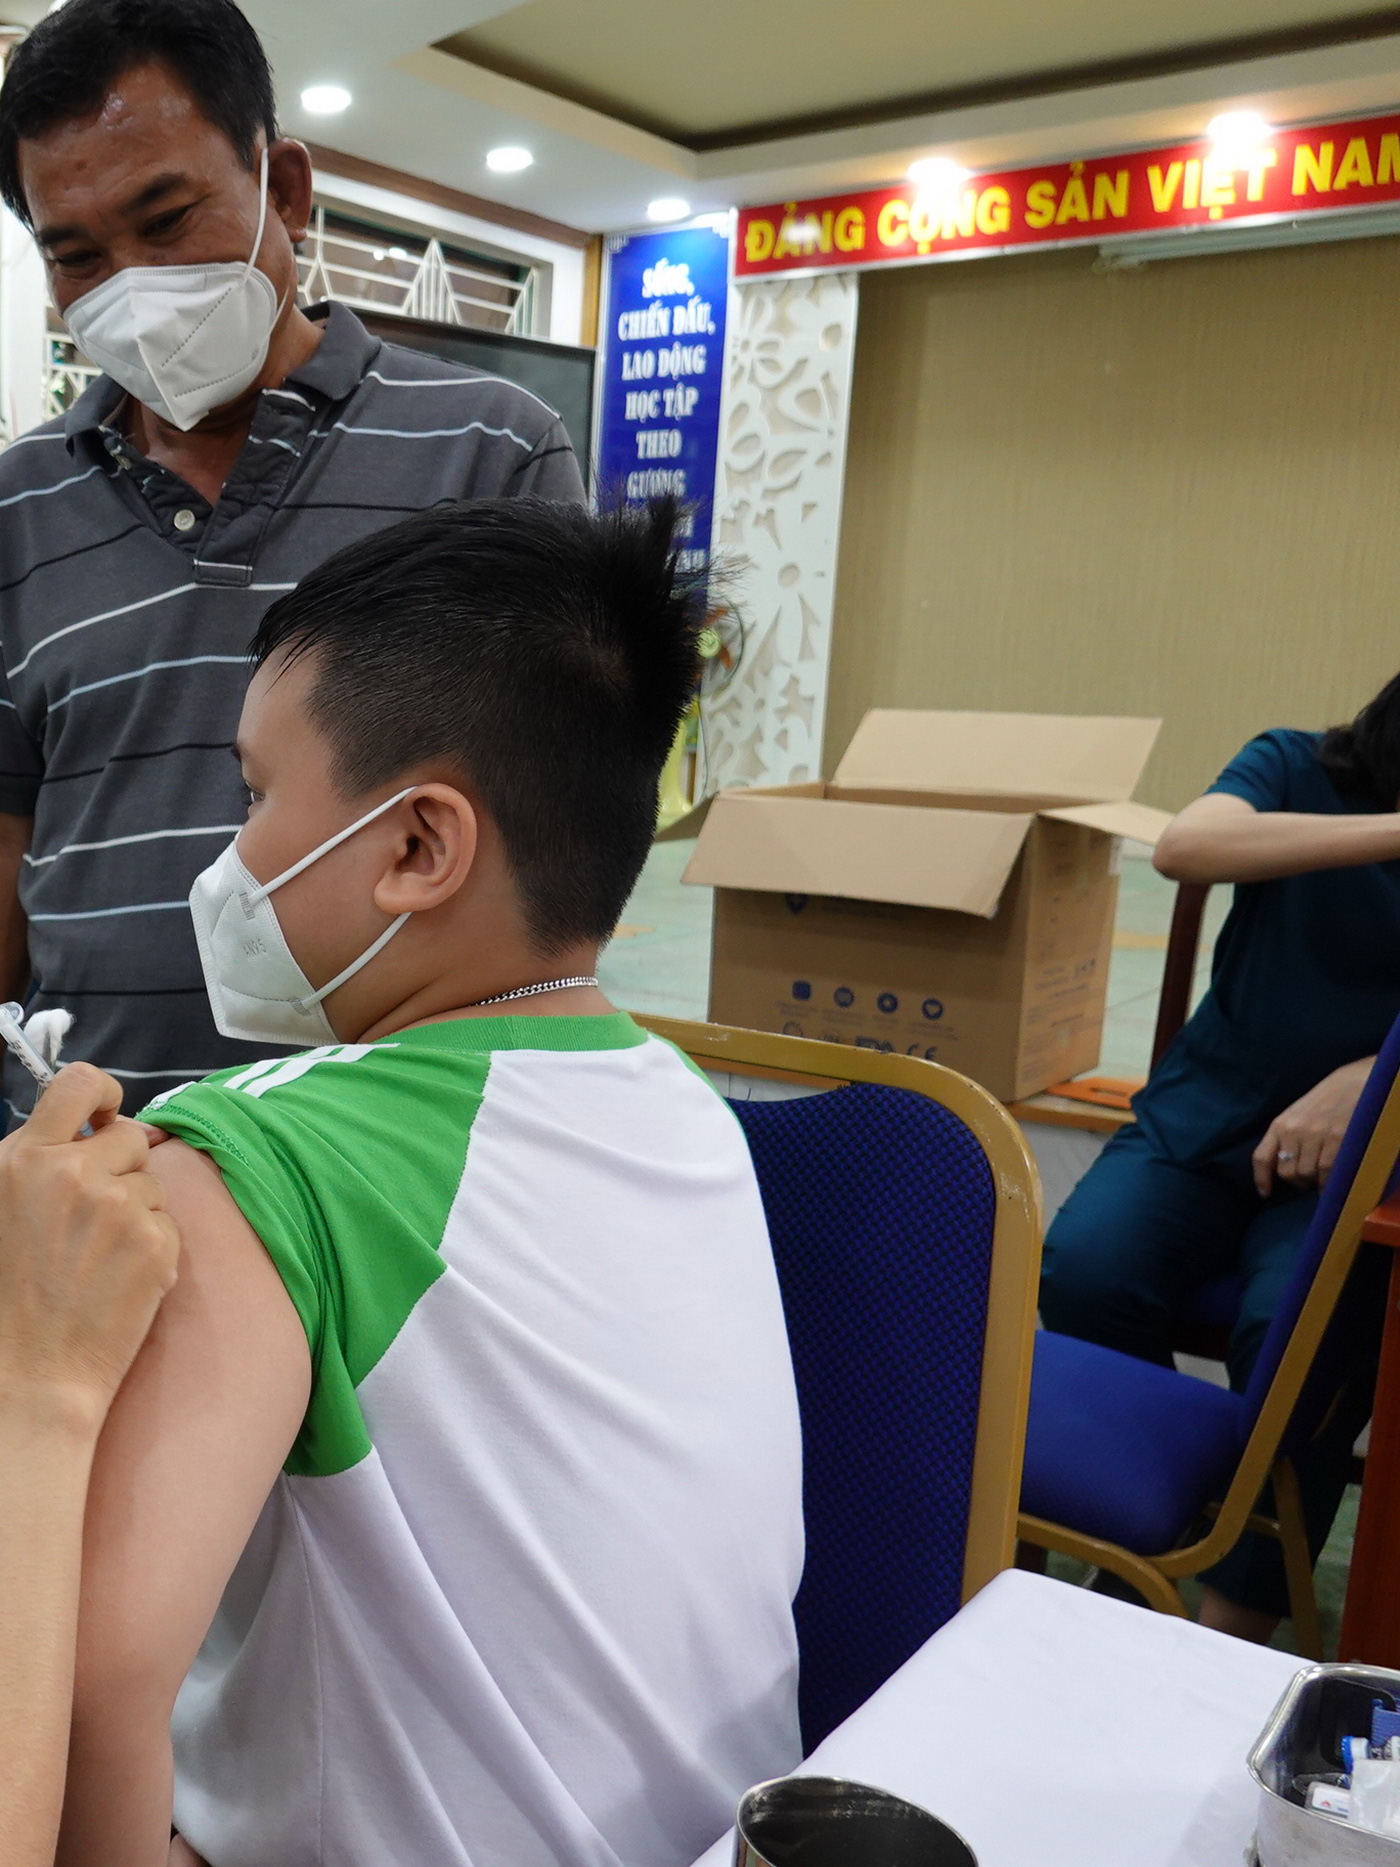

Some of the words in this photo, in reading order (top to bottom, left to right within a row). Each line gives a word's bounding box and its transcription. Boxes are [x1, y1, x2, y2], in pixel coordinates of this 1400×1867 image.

[745, 201, 865, 262] ĐẢNG
[1024, 159, 1129, 228] SẢN
[618, 299, 671, 341] CHIẾN
[621, 349, 656, 381] LAO
[657, 341, 707, 380] ĐỘNG
[625, 389, 661, 423] HỌC
[663, 382, 699, 421] TẬP
[636, 428, 682, 460] THEO
